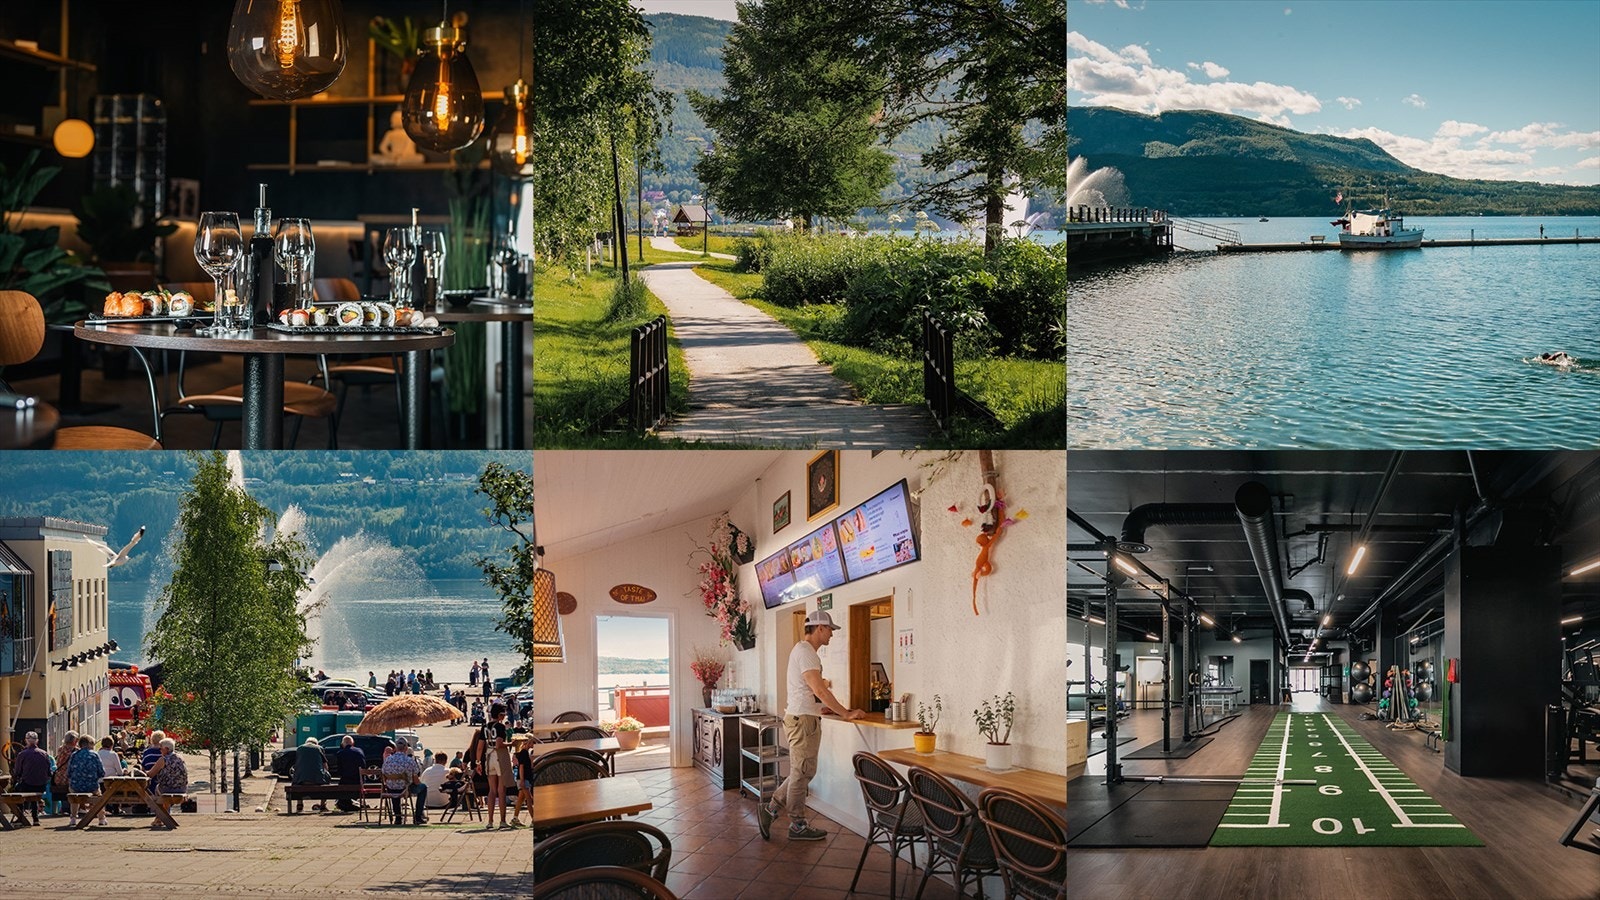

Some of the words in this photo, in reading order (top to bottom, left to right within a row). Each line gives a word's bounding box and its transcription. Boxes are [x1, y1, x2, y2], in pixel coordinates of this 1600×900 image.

[623, 586, 645, 594] TASTE
[1313, 765, 1333, 773] 8
[1318, 785, 1343, 796] 9
[1311, 817, 1376, 835] 10
